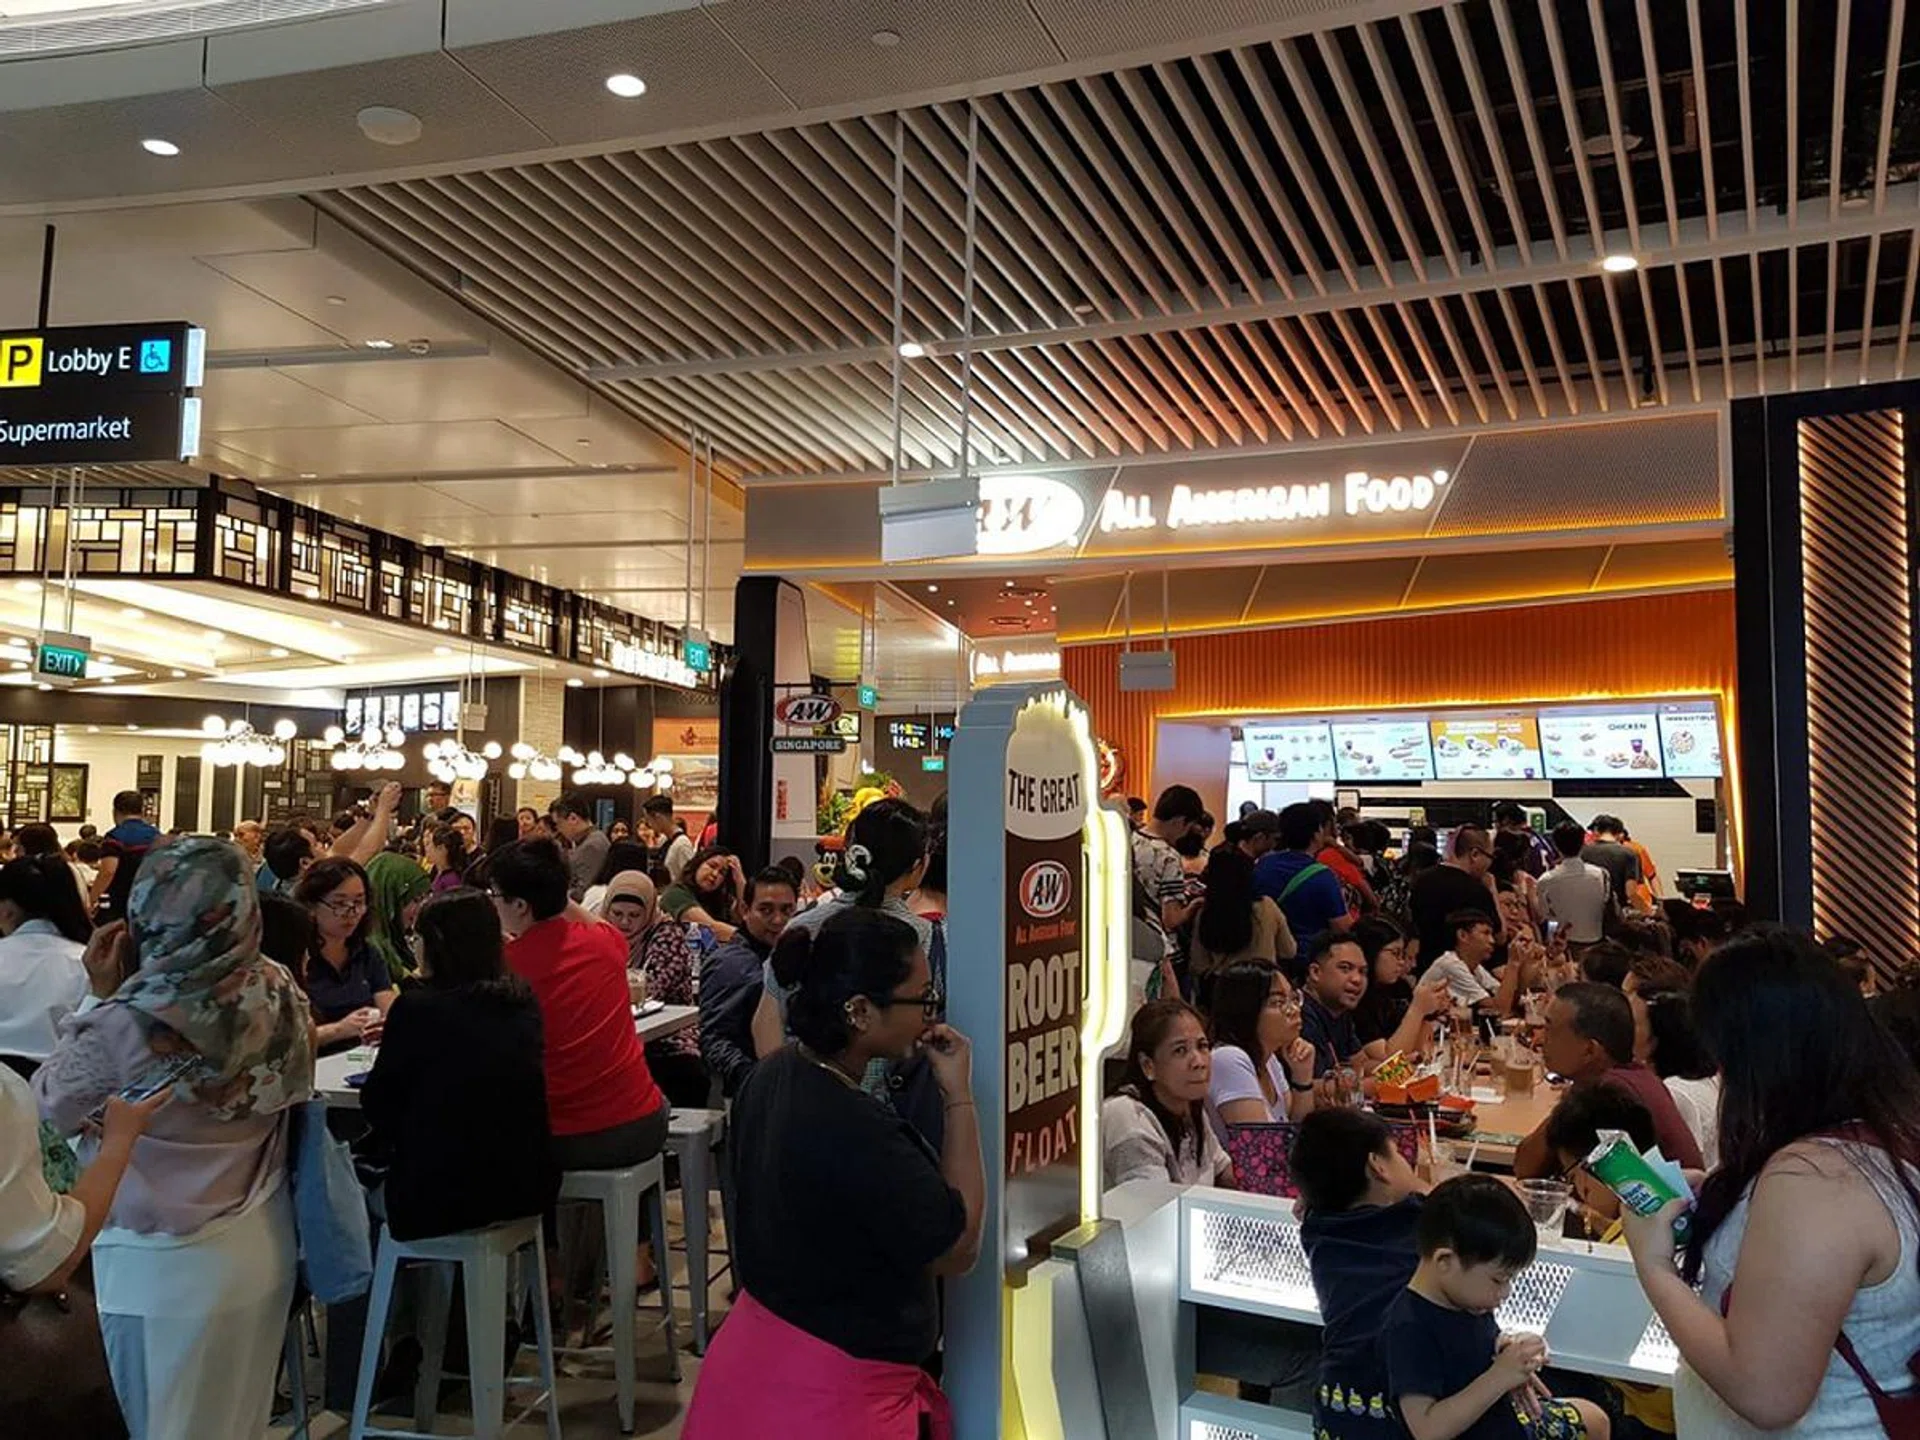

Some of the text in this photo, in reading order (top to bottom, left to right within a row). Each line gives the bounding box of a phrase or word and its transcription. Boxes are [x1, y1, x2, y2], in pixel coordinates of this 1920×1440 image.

[8, 344, 132, 381] P Lobby E
[0, 415, 131, 447] Supermarket
[46, 651, 74, 673] EXIT
[775, 740, 841, 750] SINGAPORE
[1008, 768, 1080, 813] THE GREAT
[1008, 951, 1080, 1033] ROOT
[1007, 1025, 1079, 1113] BEER
[1010, 1105, 1077, 1174] FLOAT
